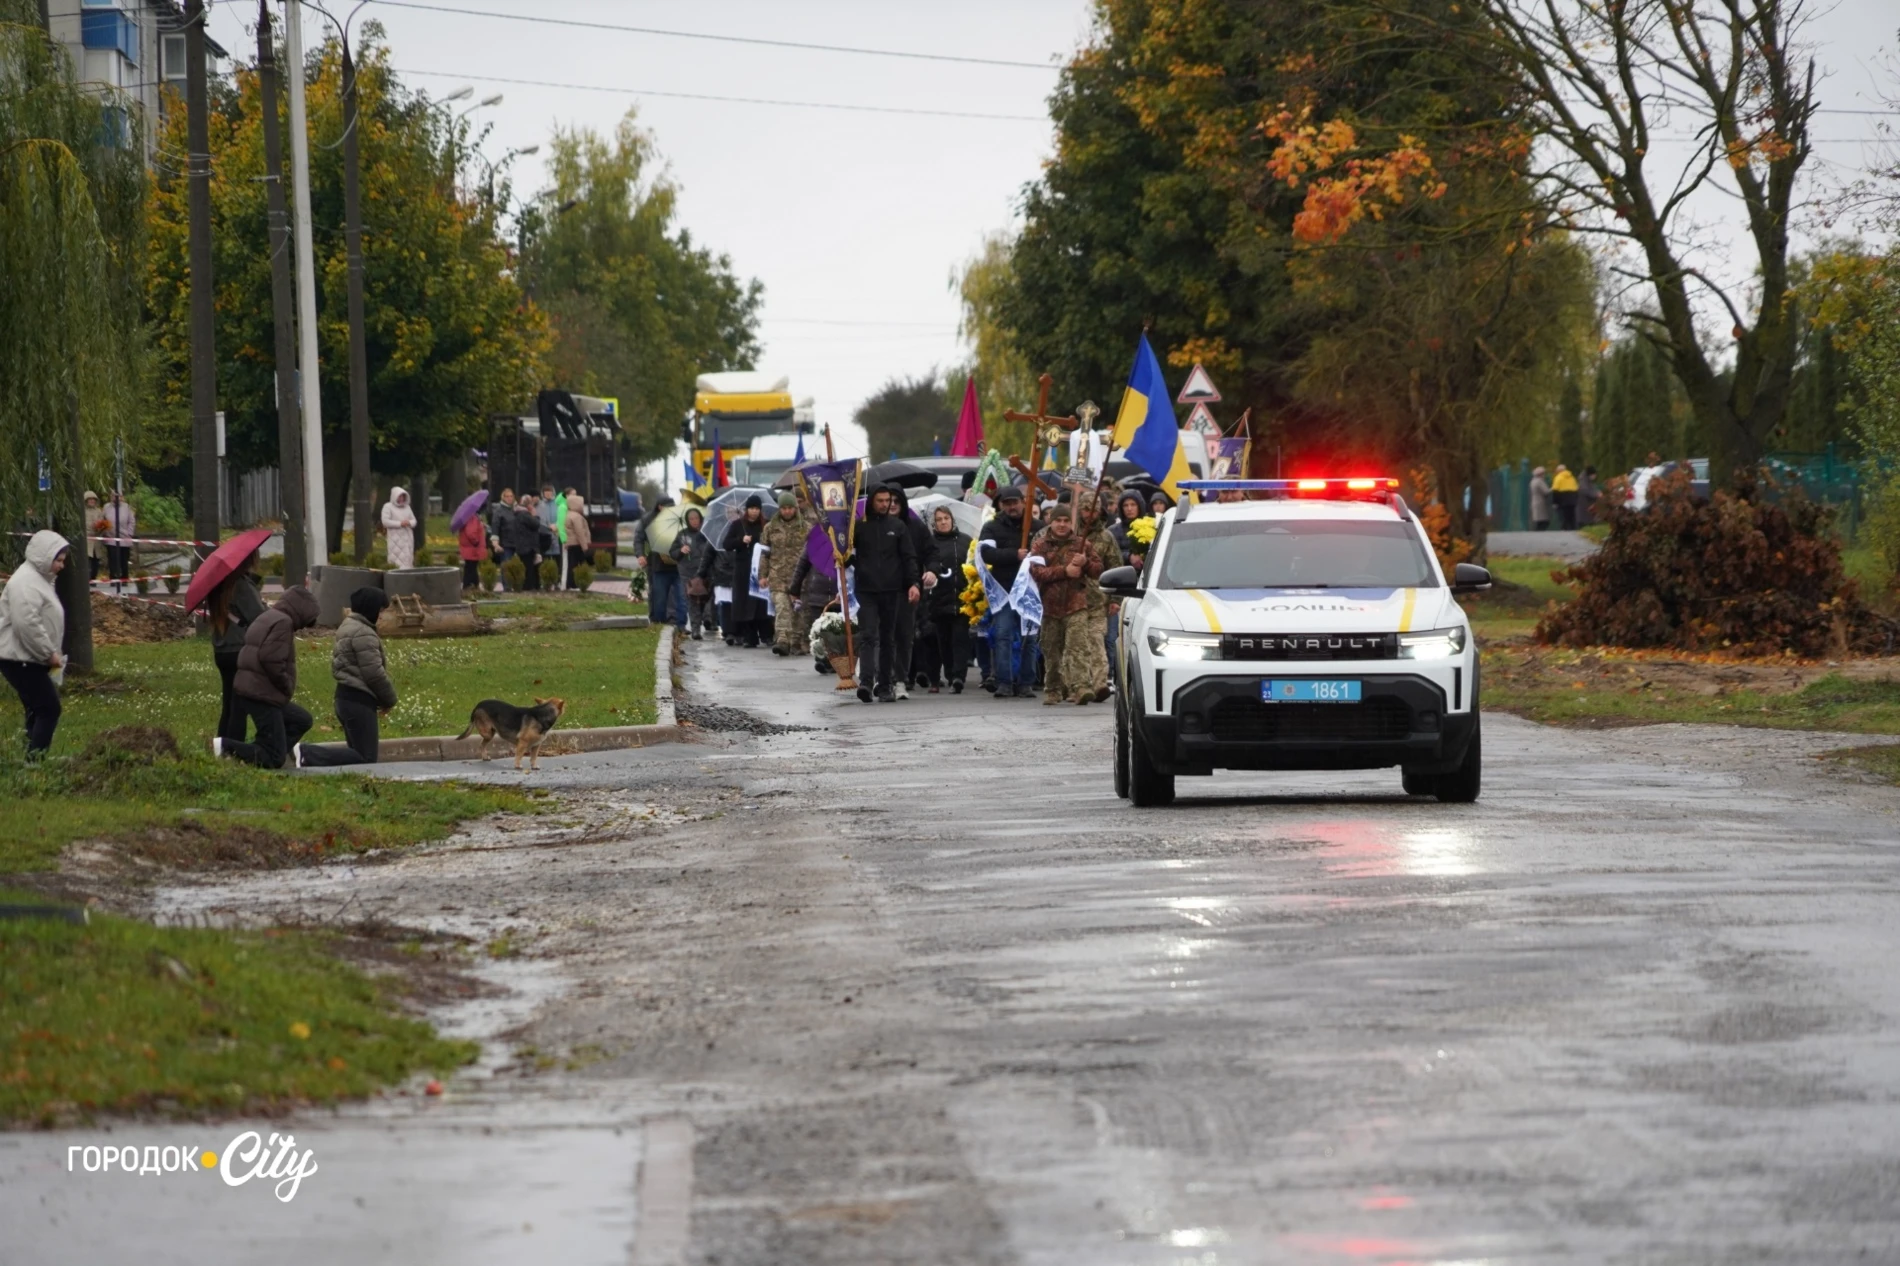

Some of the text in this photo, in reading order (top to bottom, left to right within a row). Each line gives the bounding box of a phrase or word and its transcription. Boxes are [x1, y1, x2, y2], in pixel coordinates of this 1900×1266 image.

[1240, 638, 1380, 649] RENAULT
[1262, 690, 1271, 699] 23
[1311, 682, 1349, 699] 1861
